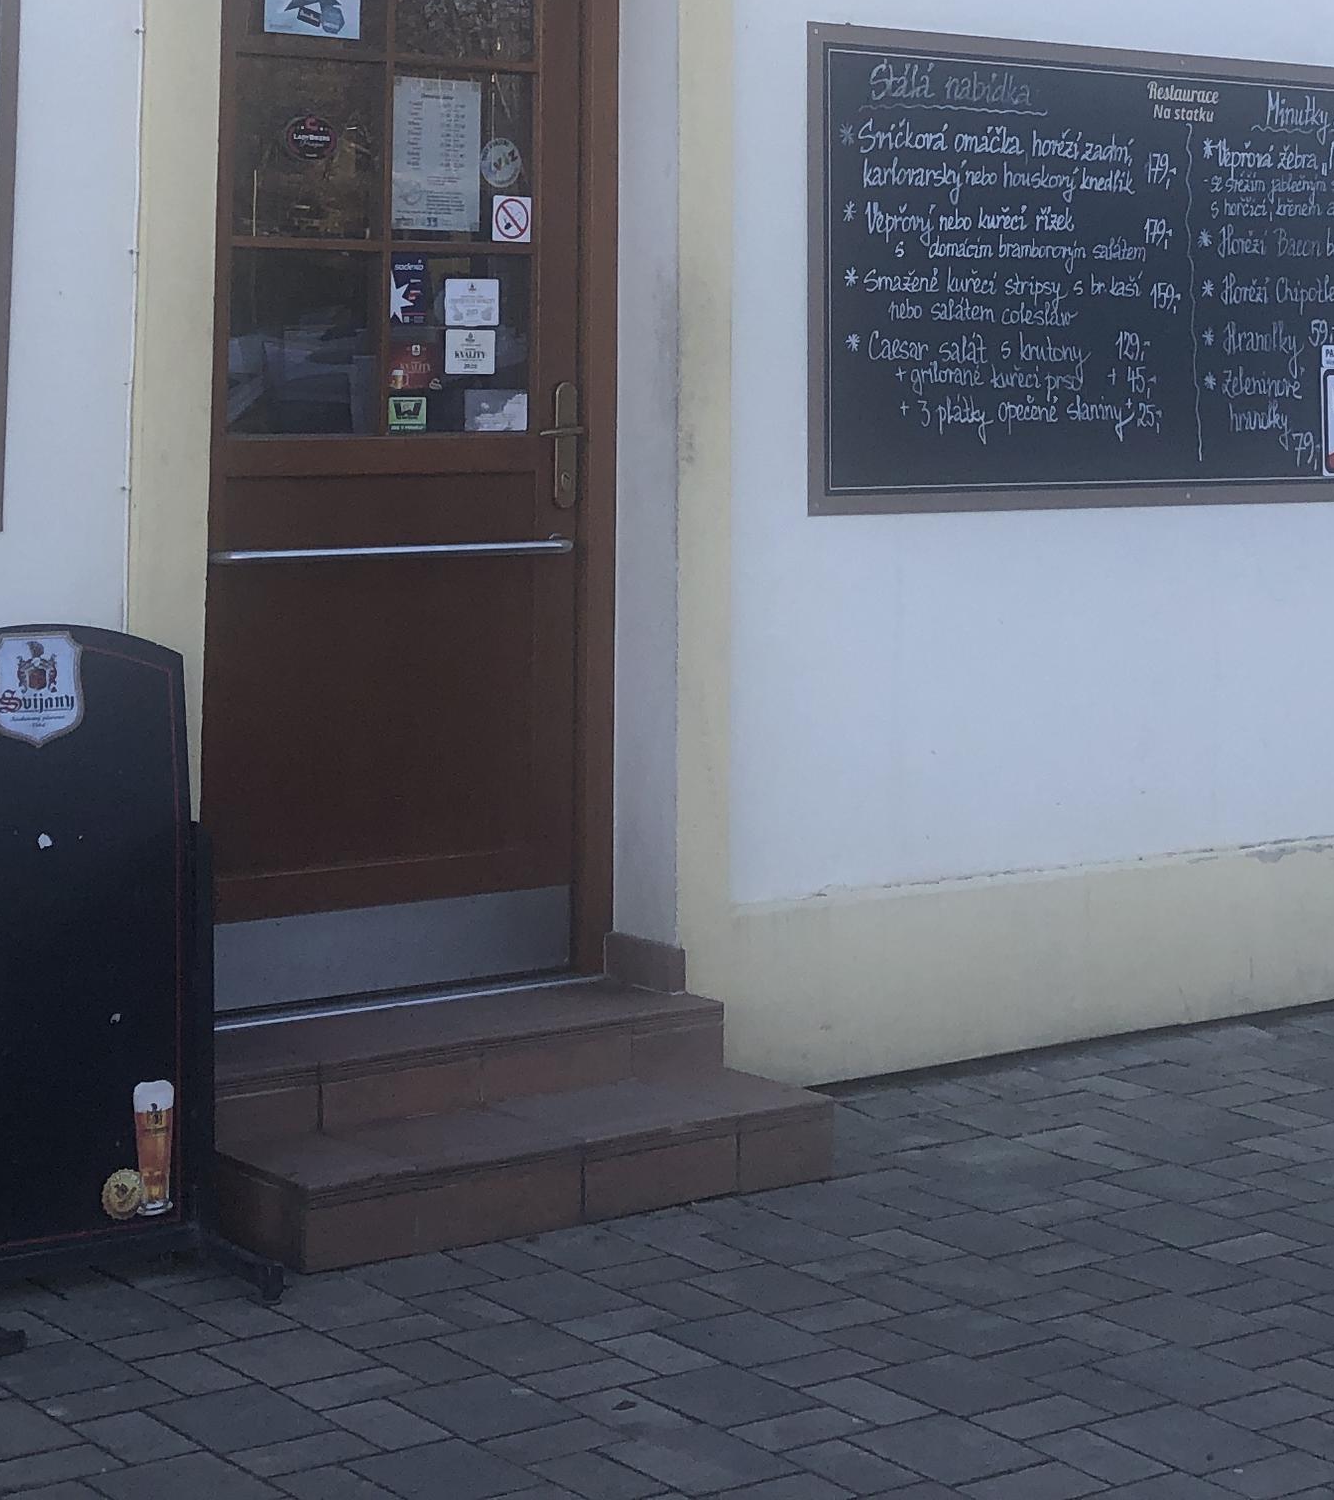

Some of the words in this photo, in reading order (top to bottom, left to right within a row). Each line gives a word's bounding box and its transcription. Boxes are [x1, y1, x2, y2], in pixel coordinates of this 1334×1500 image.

[1147, 79, 1220, 105] Restaurace
[1153, 102, 1172, 119] Na
[1174, 106, 1214, 123] statku
[1266, 89, 1330, 145] Minutky
[857, 117, 949, 154] Svíčková
[1031, 128, 1083, 160] hovězí
[1277, 143, 1319, 170] žebra
[966, 161, 998, 186] nebo
[1003, 161, 1081, 203] houskový
[1080, 168, 1136, 196] knedlík
[865, 201, 935, 246] Vepřový
[938, 199, 972, 233] nebo
[977, 204, 1028, 233] kuřecí
[1034, 206, 1075, 233] řízek
[1210, 203, 1220, 219] s
[895, 239, 906, 259] s
[928, 237, 993, 259] domácím
[1092, 235, 1147, 264] salátem
[862, 265, 939, 295] Smažené
[946, 268, 997, 297] kuřecí
[1004, 272, 1068, 308] stripsy
[1072, 280, 1084, 296] s
[888, 299, 923, 321] nebo
[930, 295, 995, 324] salátem
[1001, 301, 1080, 326] coleslaw
[868, 329, 930, 361] Caesar
[938, 331, 988, 363] salát
[1001, 338, 1012, 360] s
[1019, 330, 1093, 386] krutony
[990, 365, 1043, 391] kuřecí
[921, 400, 931, 427] 3
[937, 395, 995, 445] plátky
[997, 394, 1059, 435] opečené
[1066, 395, 1135, 442] slaniny
